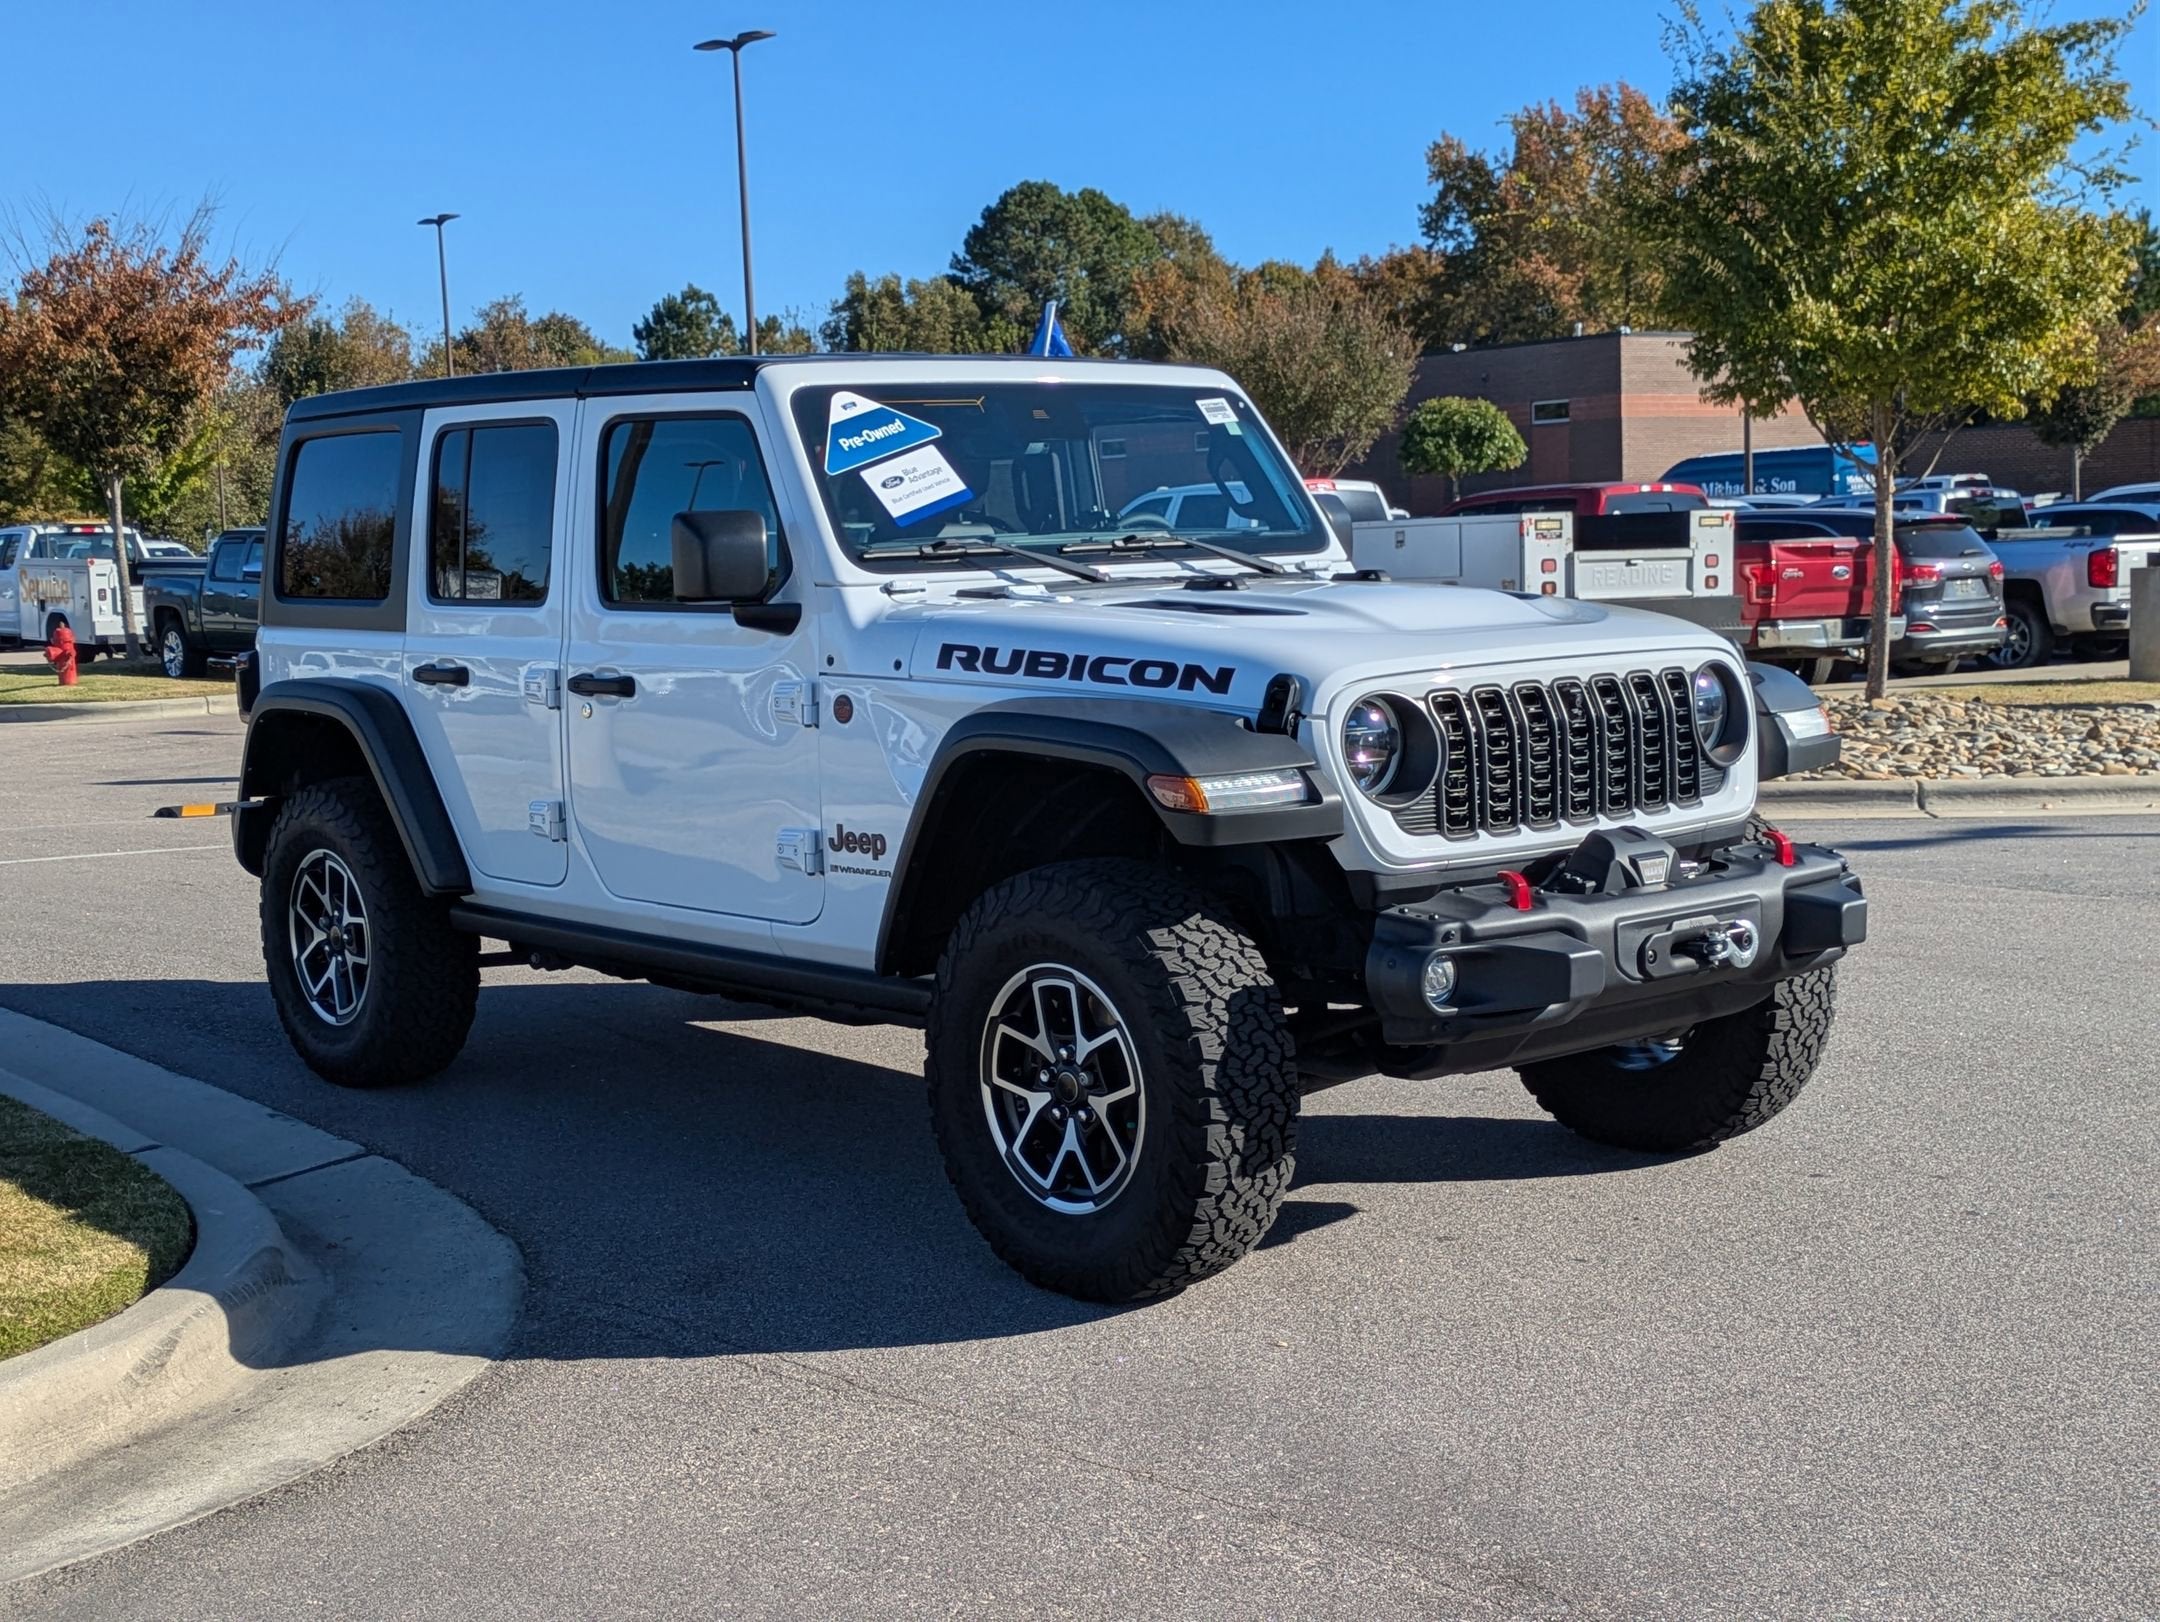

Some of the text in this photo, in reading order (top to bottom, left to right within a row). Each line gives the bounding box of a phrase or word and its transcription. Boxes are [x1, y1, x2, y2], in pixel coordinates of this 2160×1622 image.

[838, 418, 906, 451] Pre-Owned
[901, 466, 918, 476] Blue
[908, 466, 943, 484] Advantage
[1701, 476, 1797, 496] Micha & Son
[20, 568, 69, 604] Service
[1592, 565, 1672, 587] READING
[936, 642, 1236, 695] RUBICON
[828, 823, 887, 861] Jeep
[839, 865, 892, 878] WRANGLER
